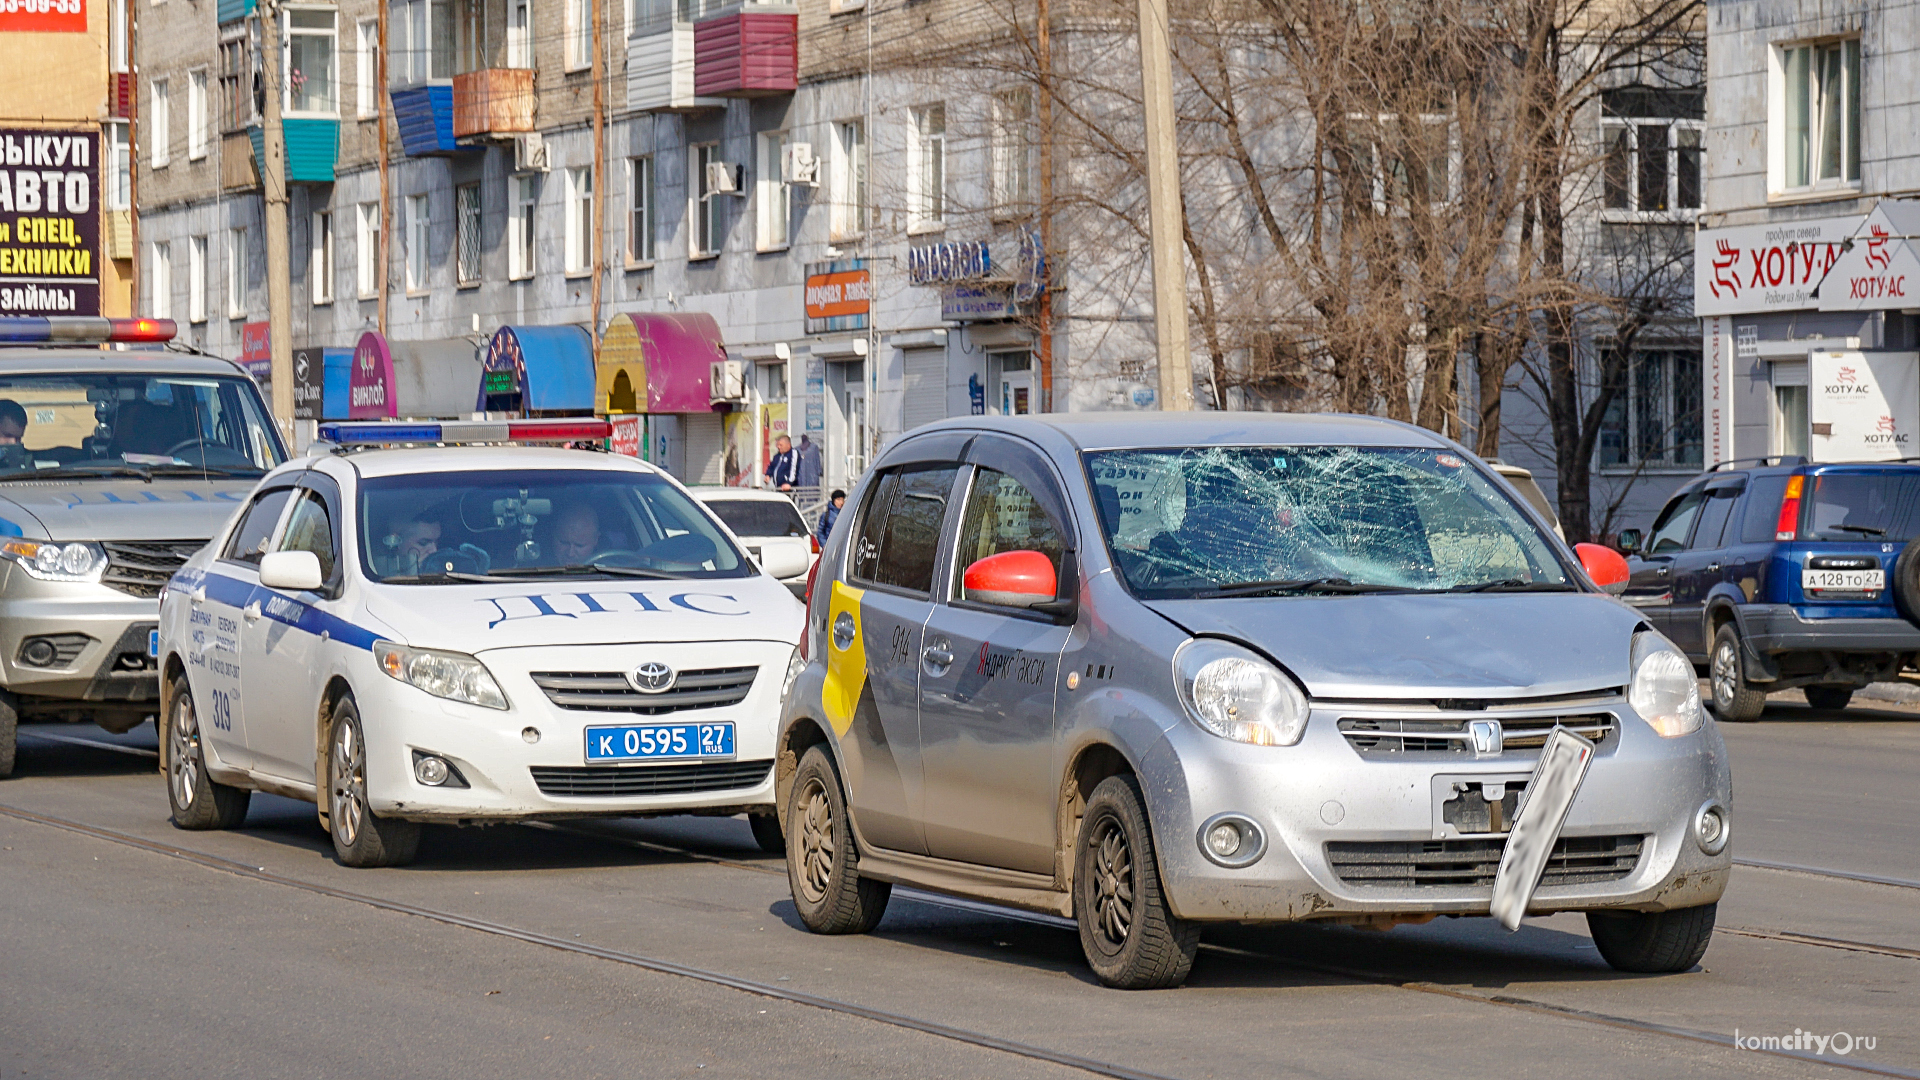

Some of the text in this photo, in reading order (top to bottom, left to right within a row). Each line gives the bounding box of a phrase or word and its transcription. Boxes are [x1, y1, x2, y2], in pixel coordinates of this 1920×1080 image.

[0, 134, 90, 167] ЫКУП
[17, 216, 82, 248] СПЕЦ.
[1, 283, 76, 311] ЗАЙМЫ
[1820, 573, 1844, 586] 128
[1866, 572, 1879, 583] 27
[474, 592, 750, 630] ДПС
[212, 688, 231, 732] 319
[600, 726, 725, 756] К 0595 27
[705, 745, 723, 753] RUS
